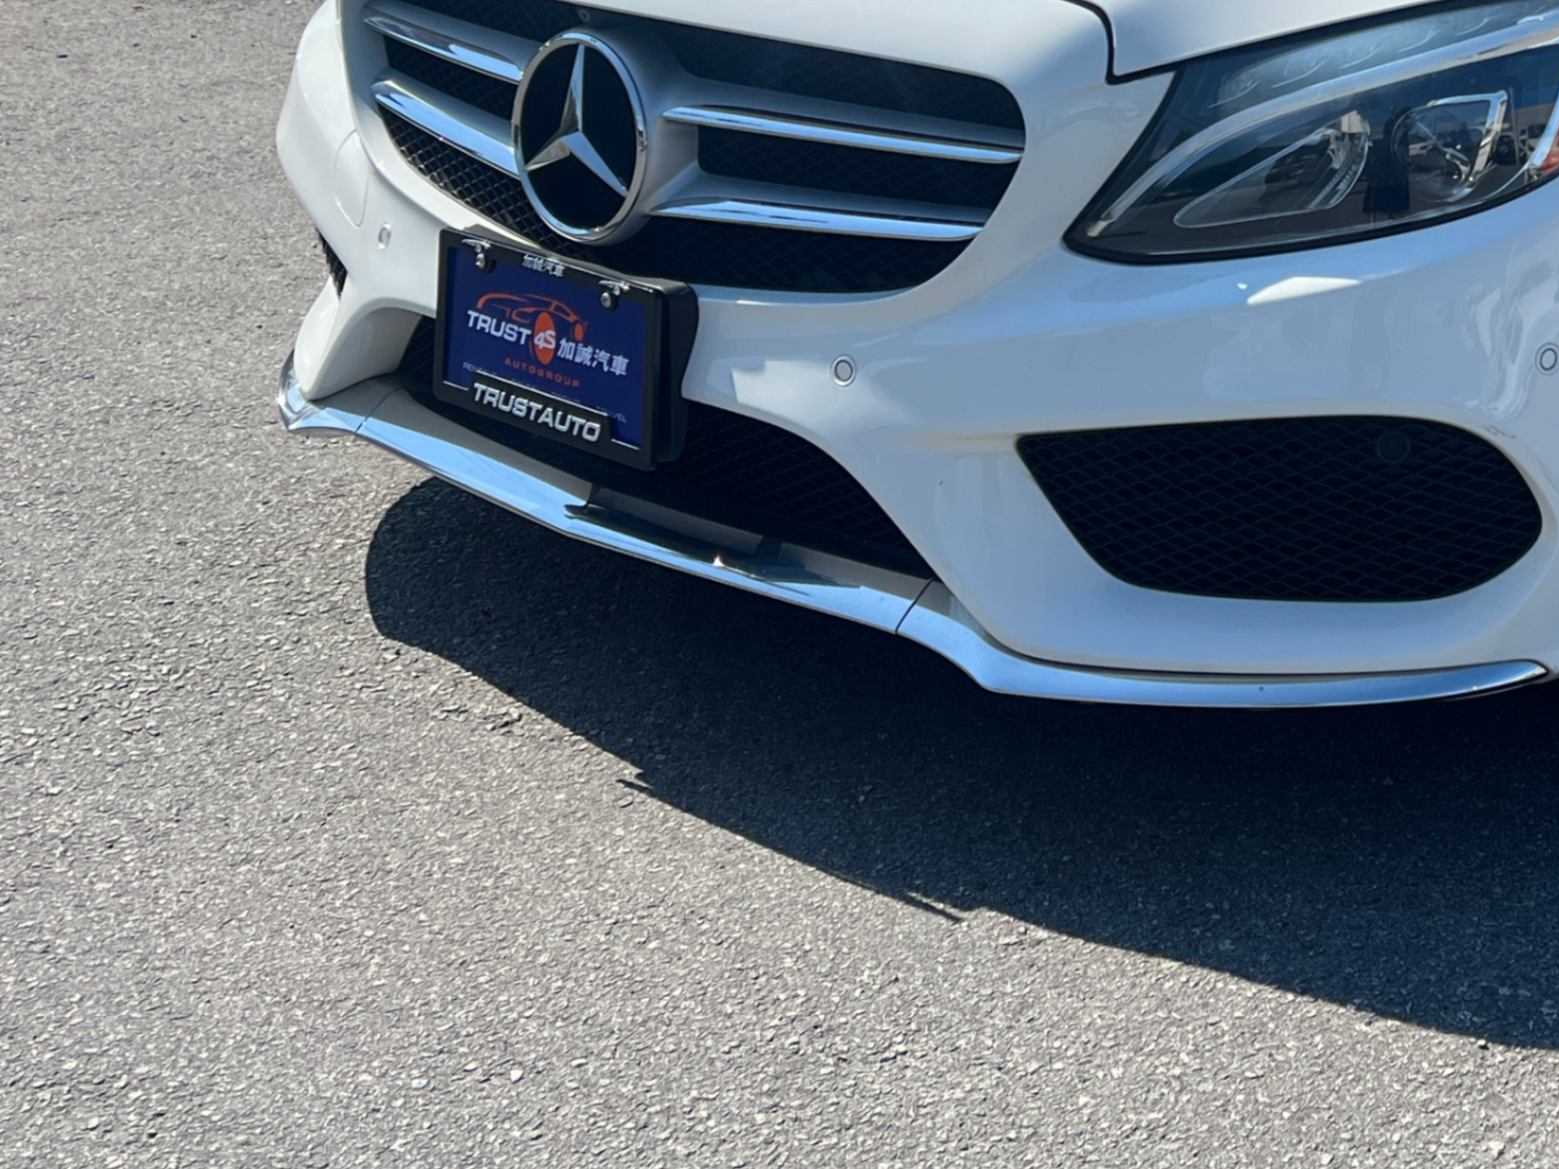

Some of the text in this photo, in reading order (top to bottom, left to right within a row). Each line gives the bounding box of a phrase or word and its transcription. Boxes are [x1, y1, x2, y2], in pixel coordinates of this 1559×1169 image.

[466, 309, 629, 377] TRUST 4S 加誠汽車
[504, 357, 581, 388] AUTOGROUP
[473, 382, 601, 442] TRUSTAUTO
